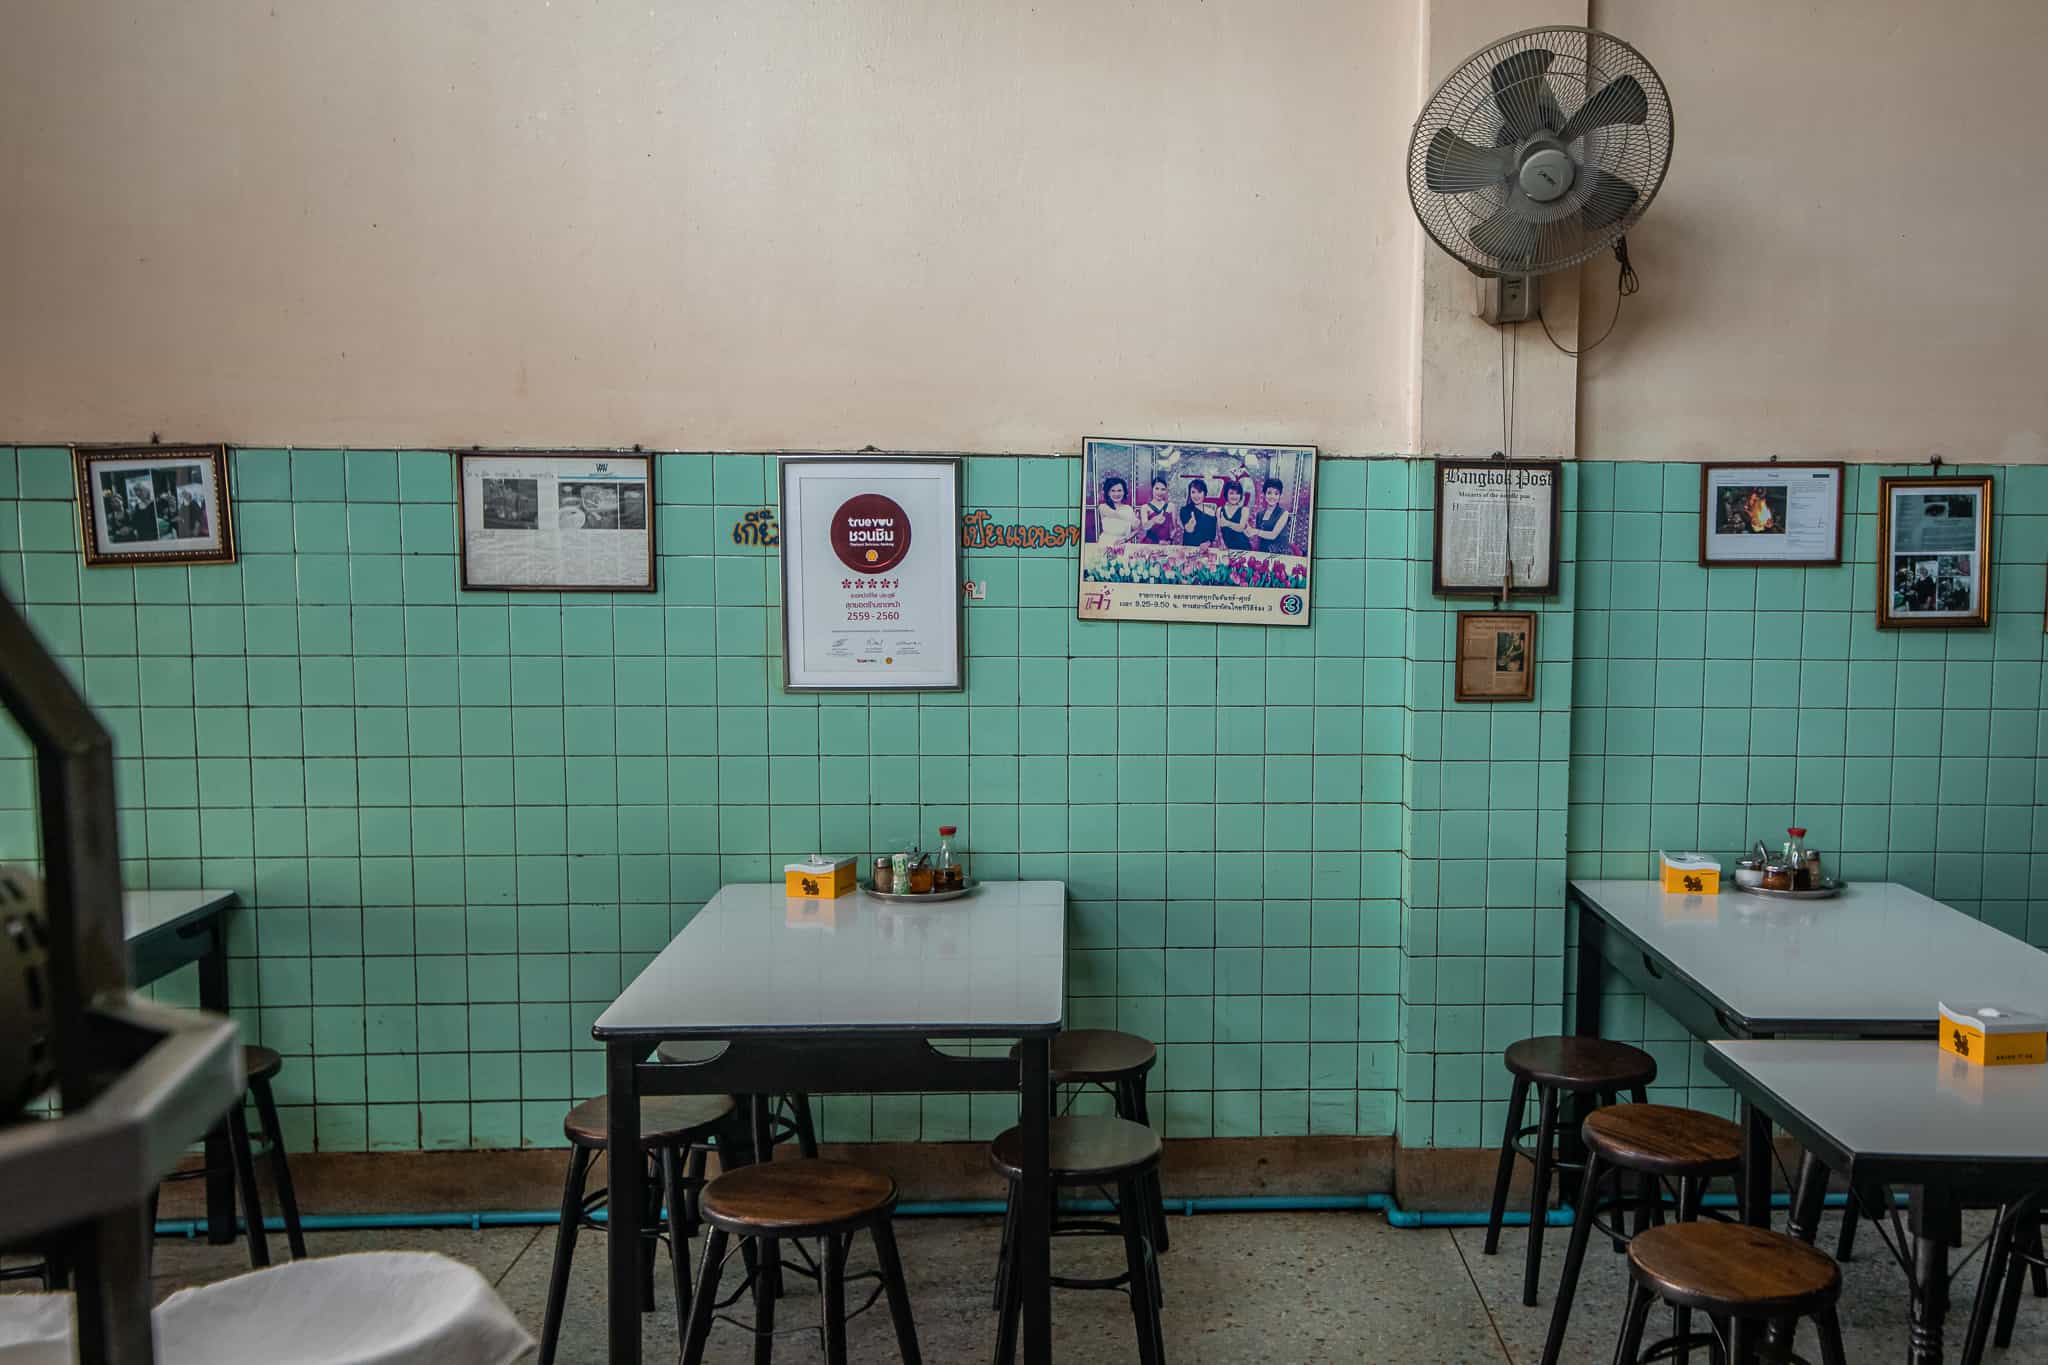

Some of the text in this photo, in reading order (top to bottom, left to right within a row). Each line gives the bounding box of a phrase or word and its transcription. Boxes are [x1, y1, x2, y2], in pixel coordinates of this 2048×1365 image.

[1446, 467, 1553, 489] Bangkok Post
[848, 528, 894, 542] ชวนชิม
[847, 611, 870, 621] 2559
[876, 611, 900, 621] 2560
